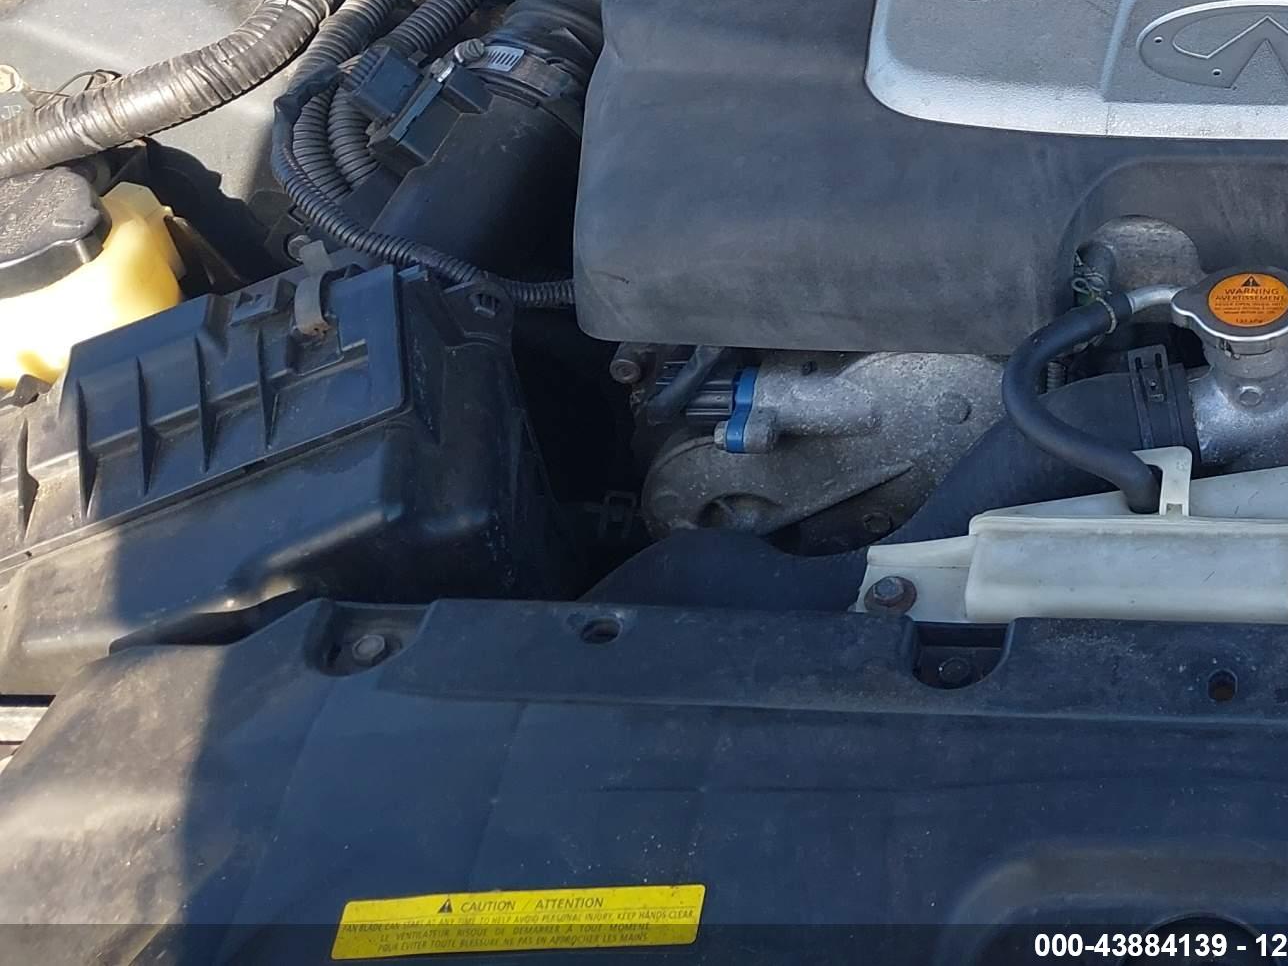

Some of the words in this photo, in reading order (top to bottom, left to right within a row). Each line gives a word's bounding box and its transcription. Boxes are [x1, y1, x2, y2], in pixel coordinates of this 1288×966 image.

[1224, 287, 1280, 295] WARNING
[460, 900, 516, 913] CAUTION
[535, 897, 604, 909] ATTENTION
[514, 914, 541, 923] AVOID
[617, 911, 637, 920] KEEP
[639, 910, 667, 919] HANDS
[396, 929, 450, 941] VENTILATEUR
